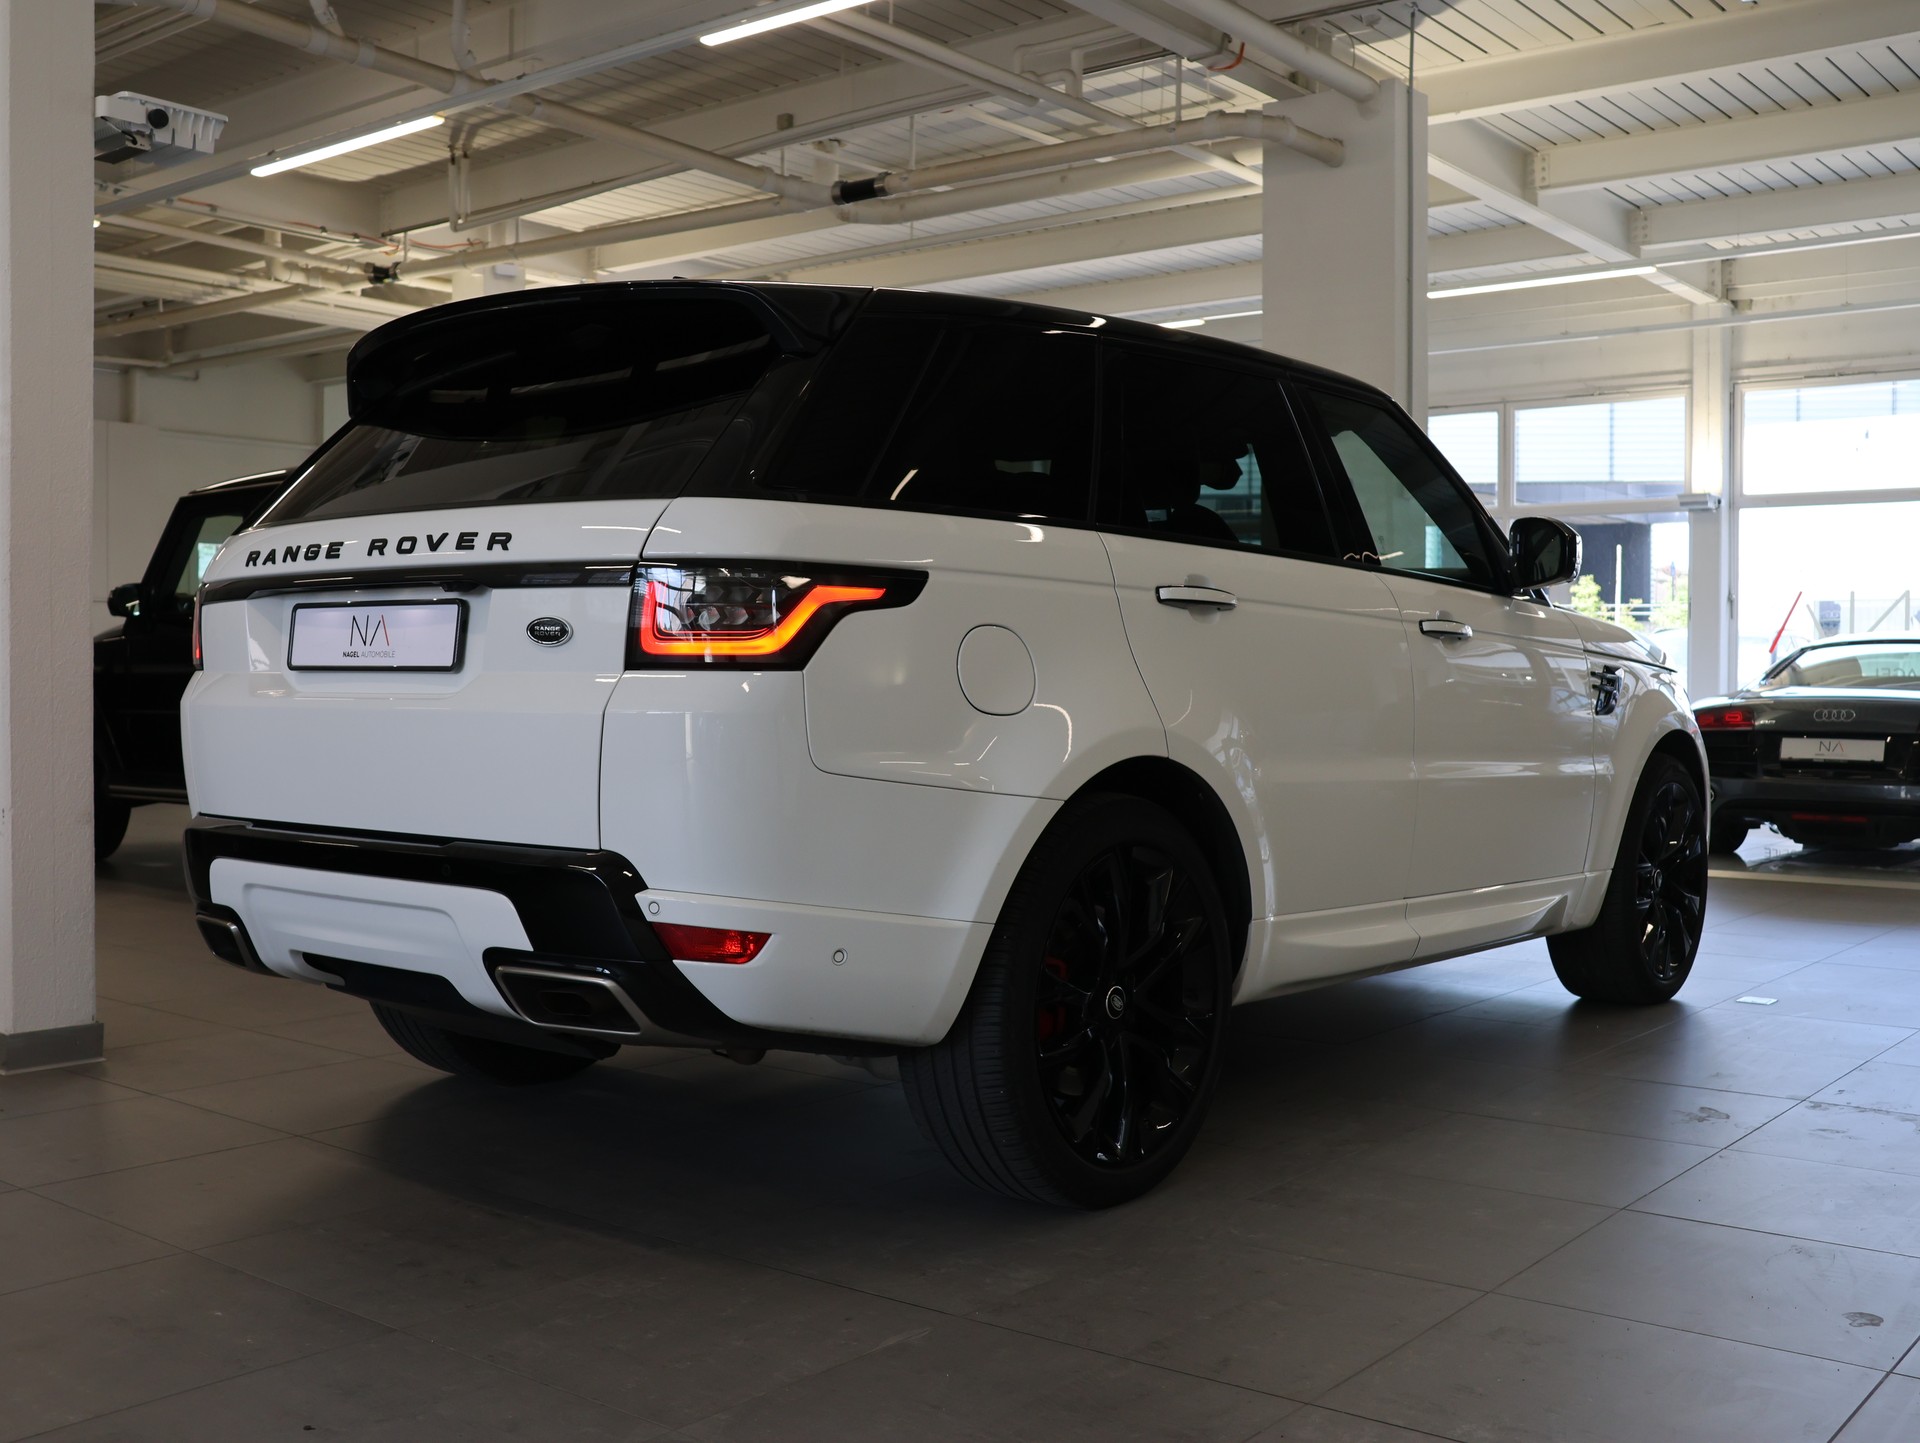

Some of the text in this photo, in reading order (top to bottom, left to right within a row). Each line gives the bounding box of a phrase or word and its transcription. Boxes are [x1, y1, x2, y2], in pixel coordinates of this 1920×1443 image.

[245, 531, 513, 567] RANGE ROVER
[350, 614, 389, 647] NA
[361, 650, 396, 658] AUTOMOBILE
[1819, 741, 1844, 752] NA
